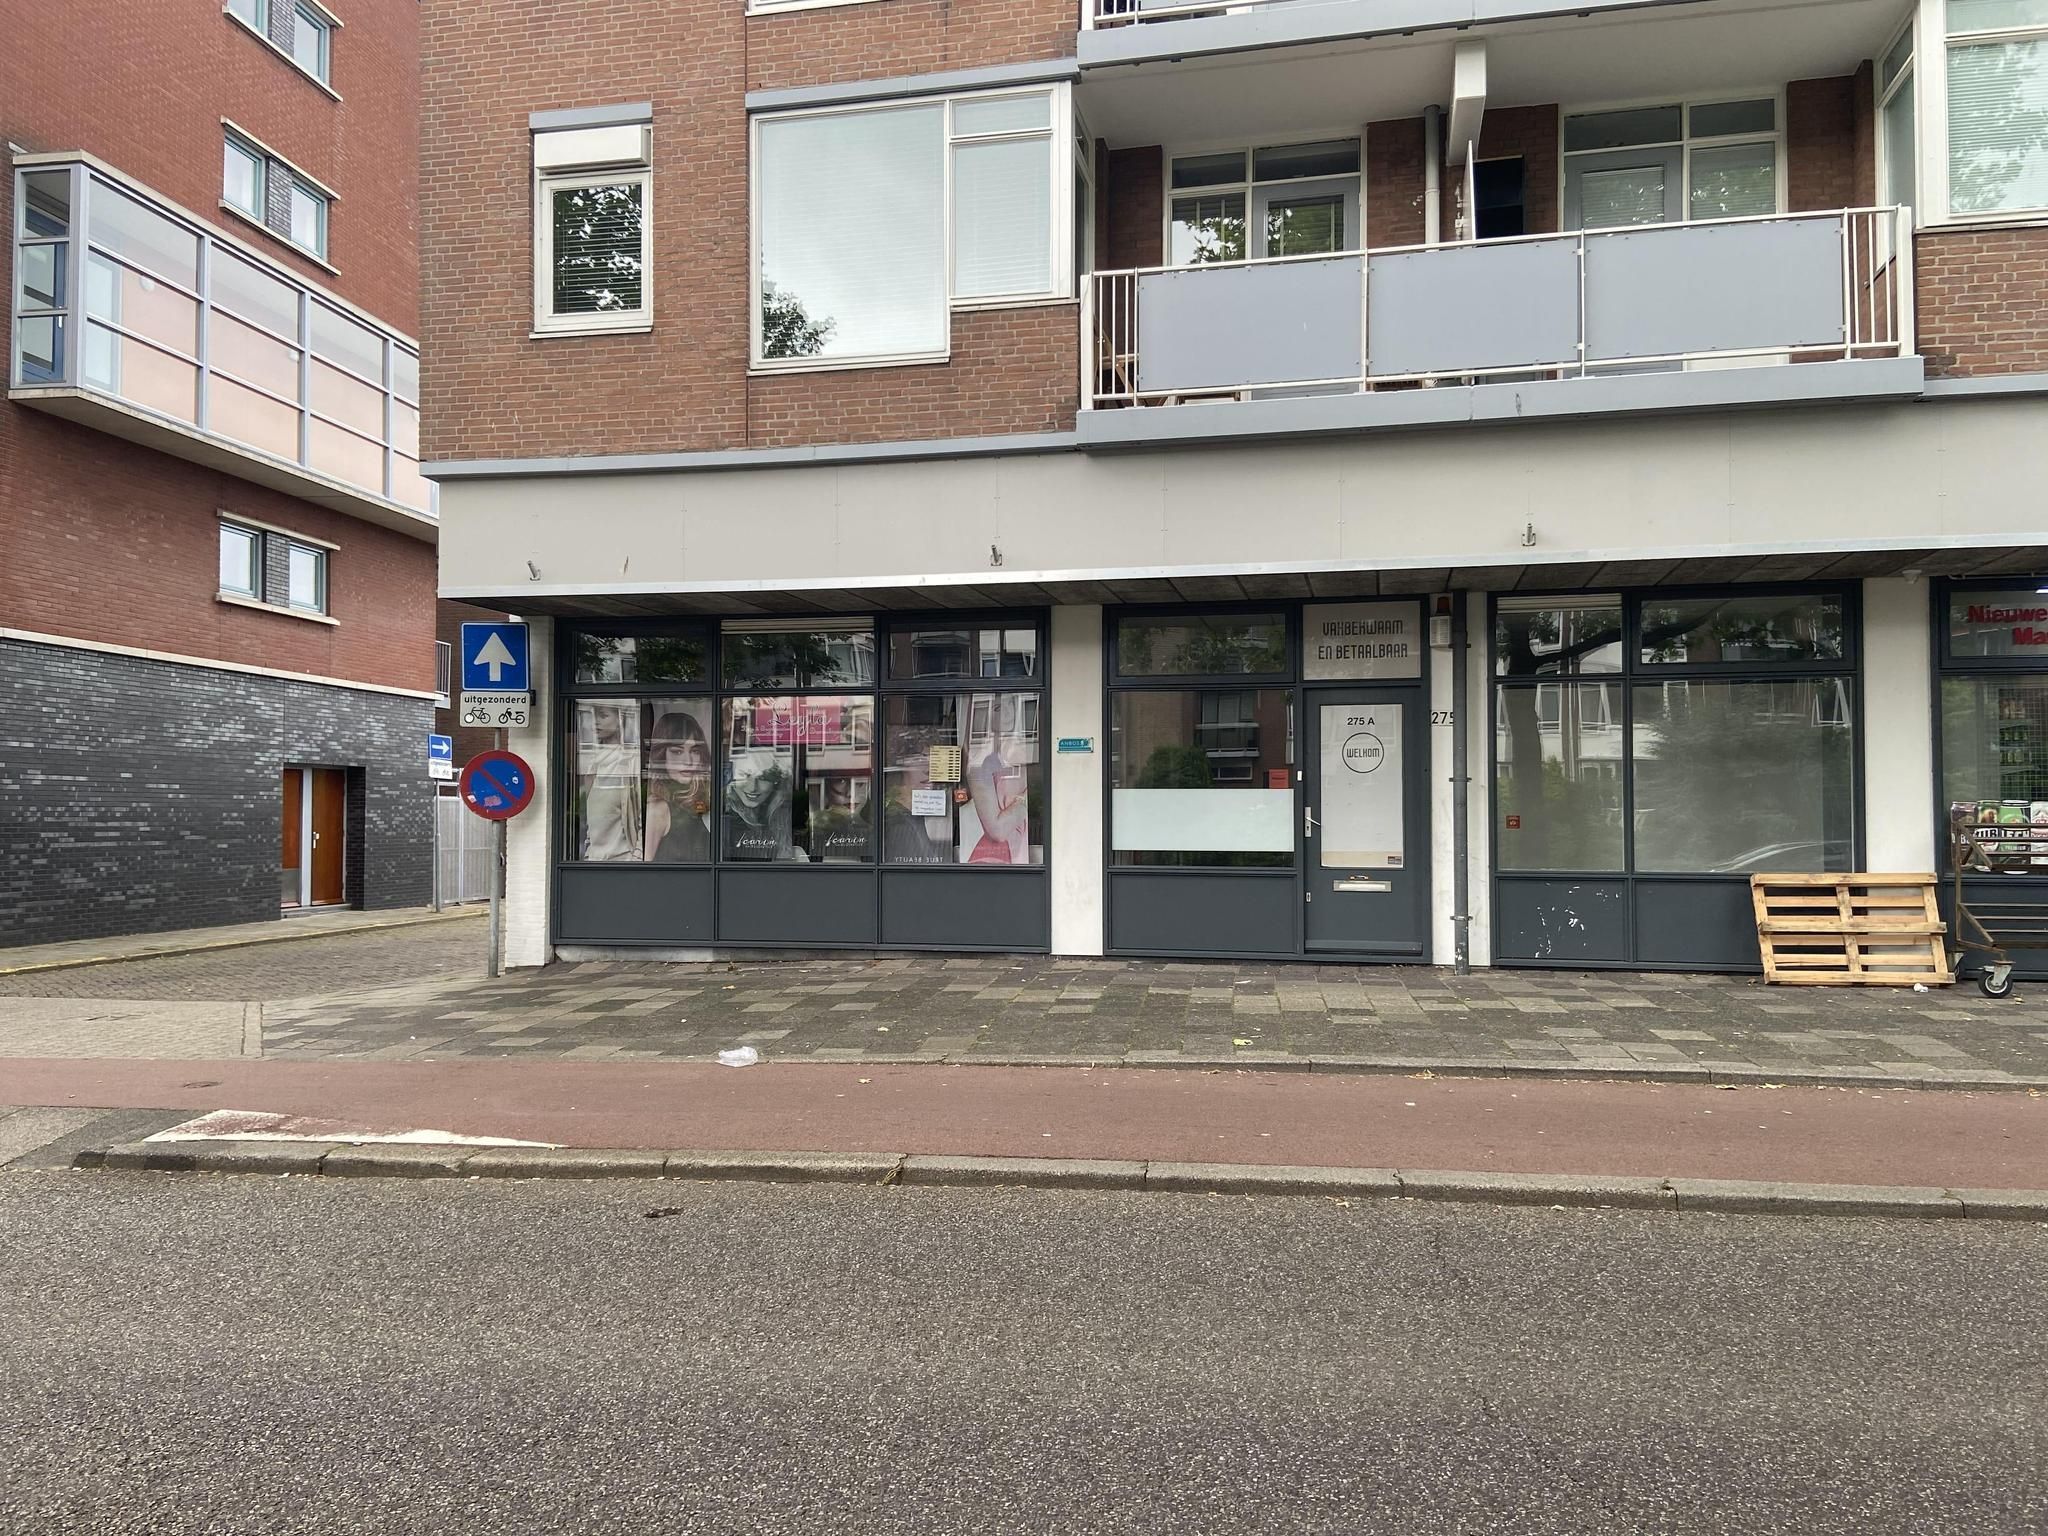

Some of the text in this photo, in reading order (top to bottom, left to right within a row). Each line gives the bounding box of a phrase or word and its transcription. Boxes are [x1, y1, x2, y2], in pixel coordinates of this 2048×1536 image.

[1968, 604, 2047, 623] Nieuwe
[1322, 620, 1403, 636] VAKBEKWAAM
[1318, 643, 1408, 660] EN BETAALBAAR
[464, 695, 527, 705] uitgezonderd
[1347, 717, 1375, 726] 275 A
[1346, 748, 1380, 758] WELKOM
